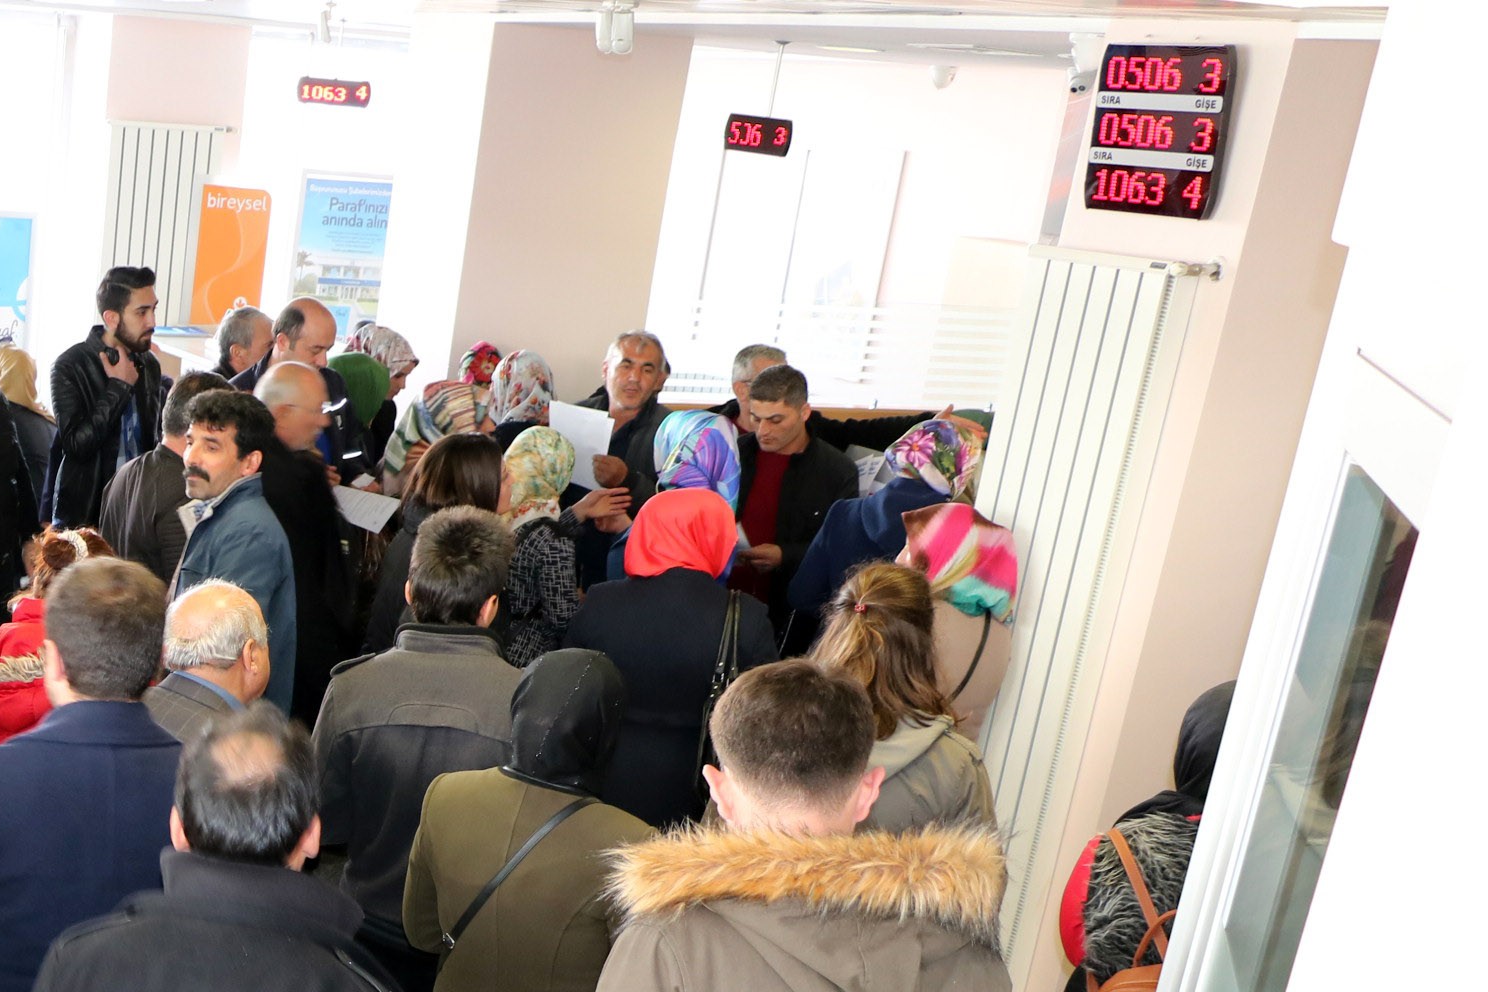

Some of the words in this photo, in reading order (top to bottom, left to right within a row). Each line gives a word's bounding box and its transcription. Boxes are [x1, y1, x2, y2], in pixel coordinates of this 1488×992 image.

[1106, 56, 1182, 91] 0506
[1198, 58, 1223, 93] 3
[301, 84, 347, 102] 1063
[355, 85, 368, 100] 4
[1101, 95, 1121, 105] SIRA
[1195, 98, 1216, 111] GİŞE
[773, 126, 788, 146] 3
[1098, 113, 1174, 149] 0506
[1190, 117, 1214, 152] 3
[1093, 151, 1113, 161] SIRA
[1186, 157, 1207, 169] GİŞE
[1092, 168, 1166, 206] 1063
[1182, 175, 1203, 210] 4
[207, 192, 267, 213] bireysel
[322, 213, 364, 228] anında
